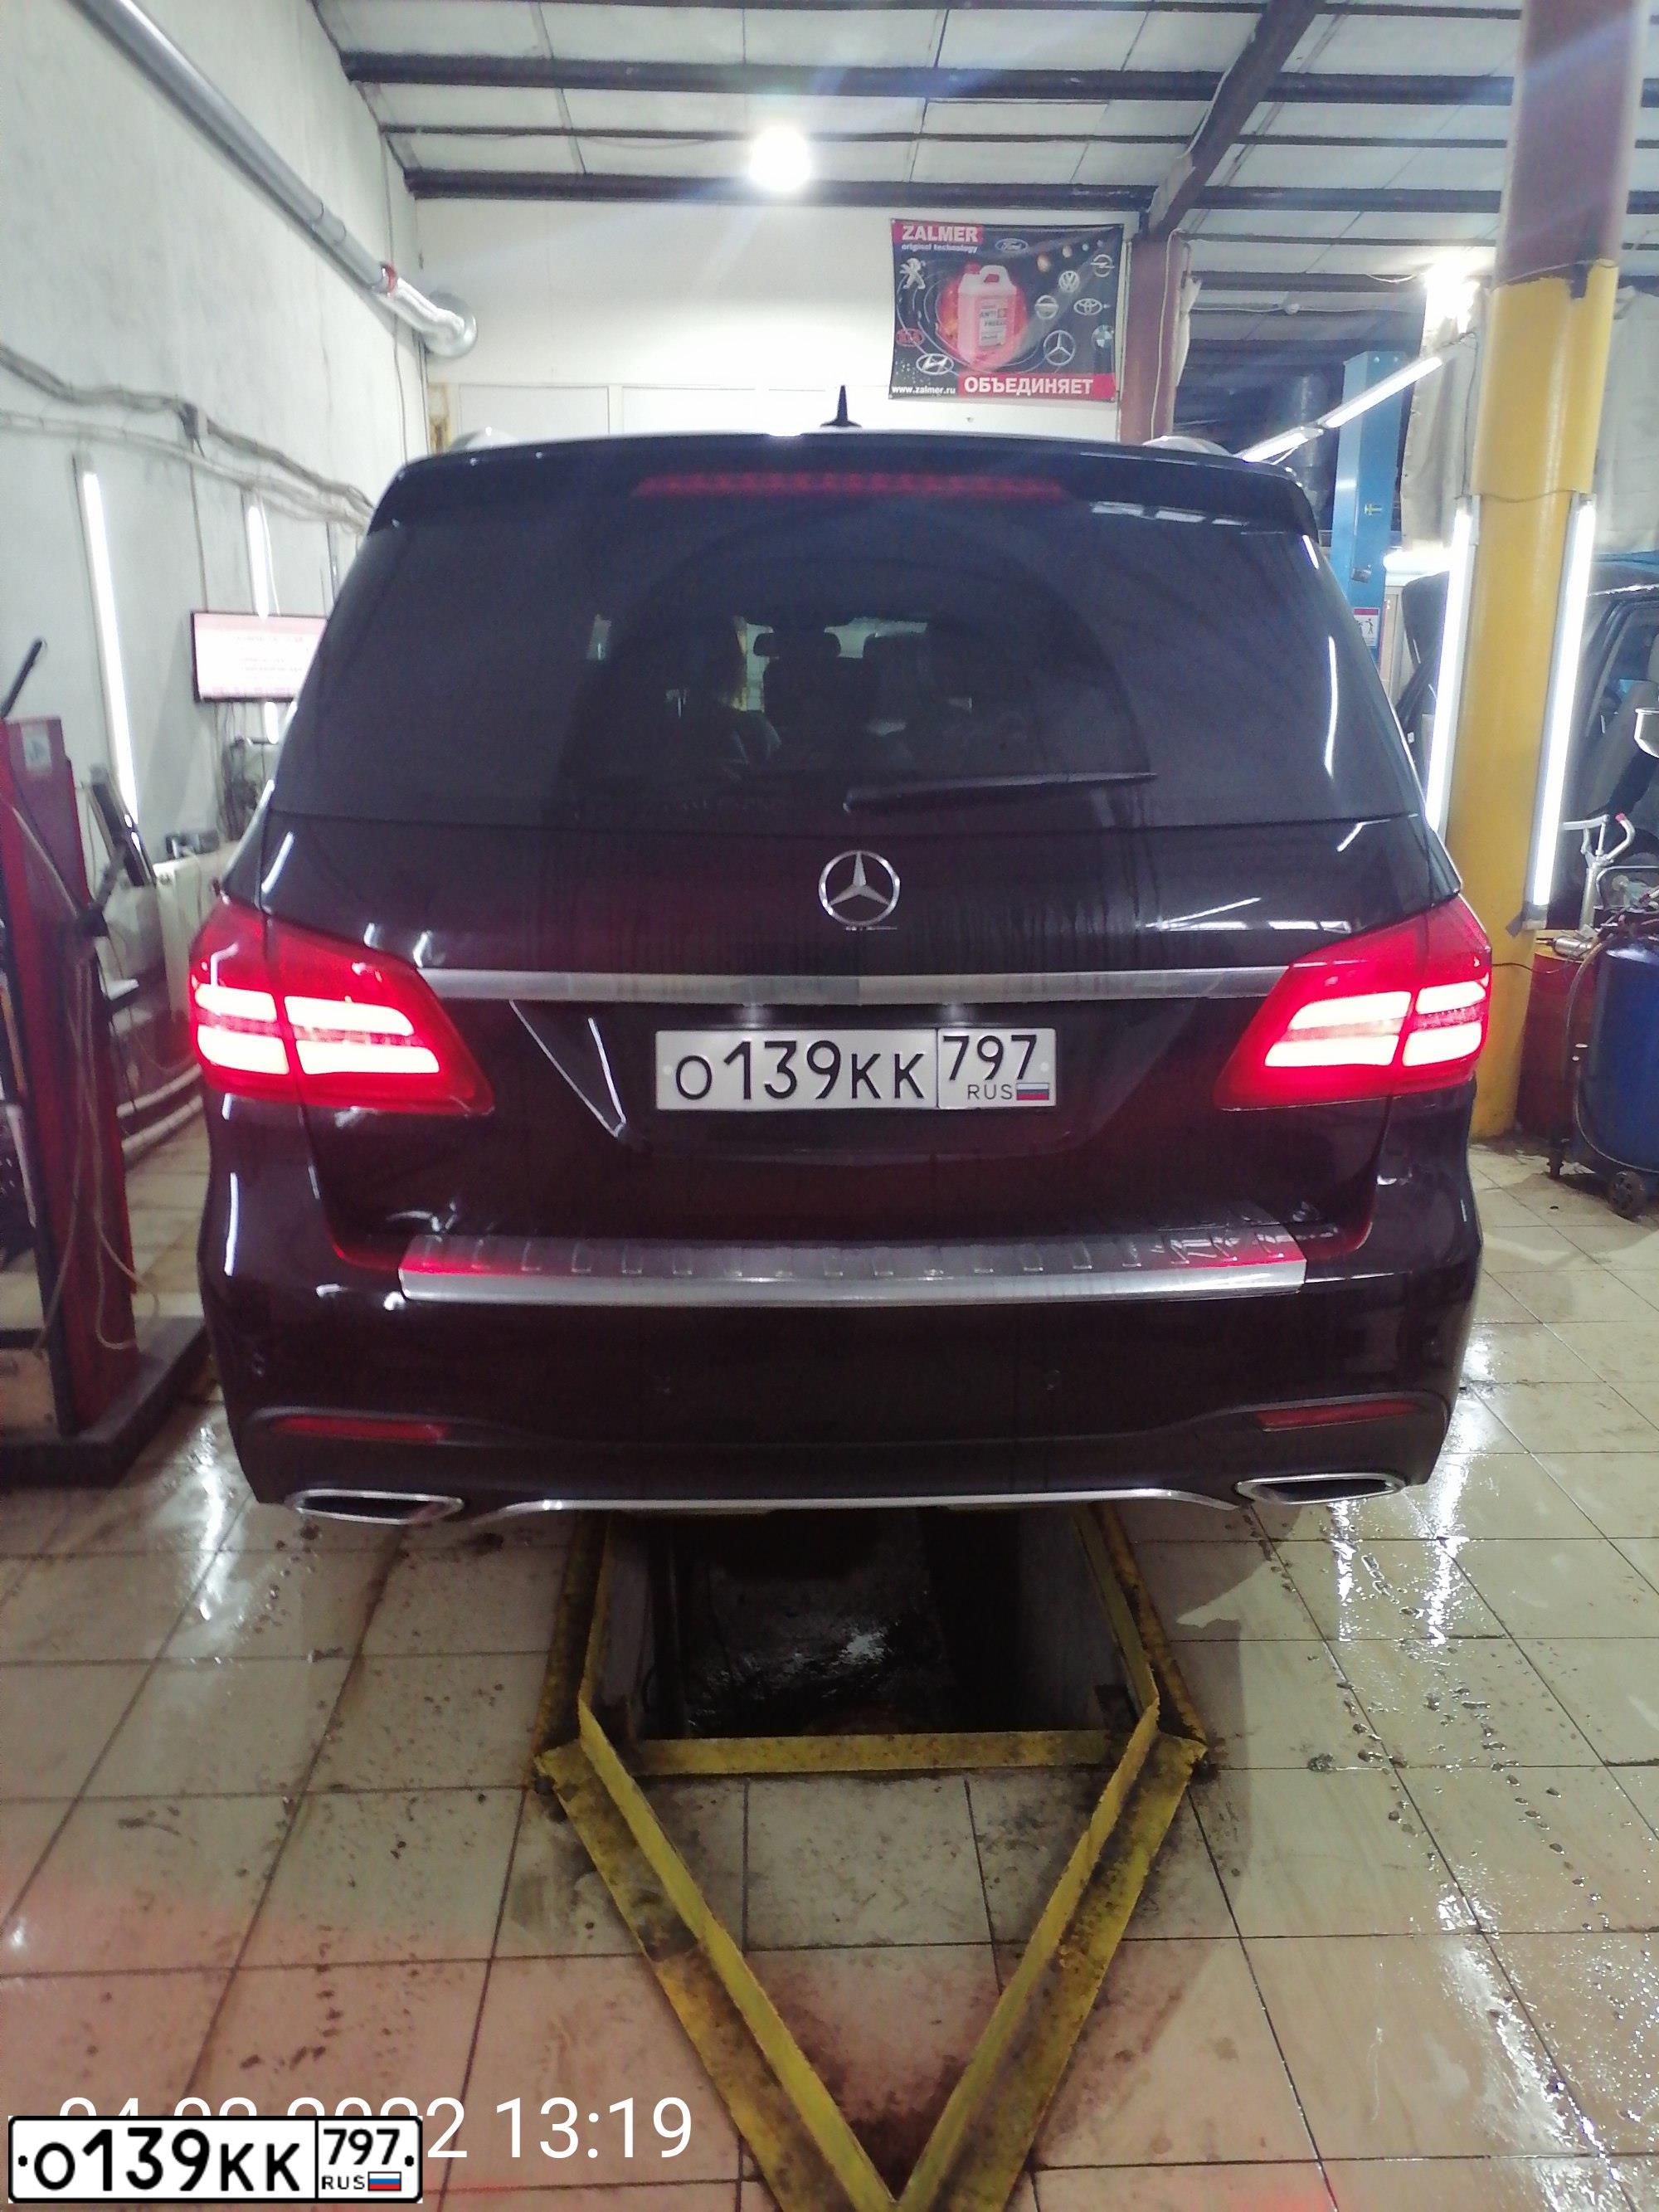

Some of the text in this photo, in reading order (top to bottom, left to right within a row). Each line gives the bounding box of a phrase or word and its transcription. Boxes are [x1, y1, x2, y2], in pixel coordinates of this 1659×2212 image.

[902, 225, 979, 243] ZALMER
[933, 244, 978, 254] technology
[891, 386, 956, 394] www.zalmer.ru
[964, 377, 1094, 396] ОБЪЕДИНЯЕТ
[942, 1034, 1038, 1081] 797
[967, 1084, 1013, 1100] RUS
